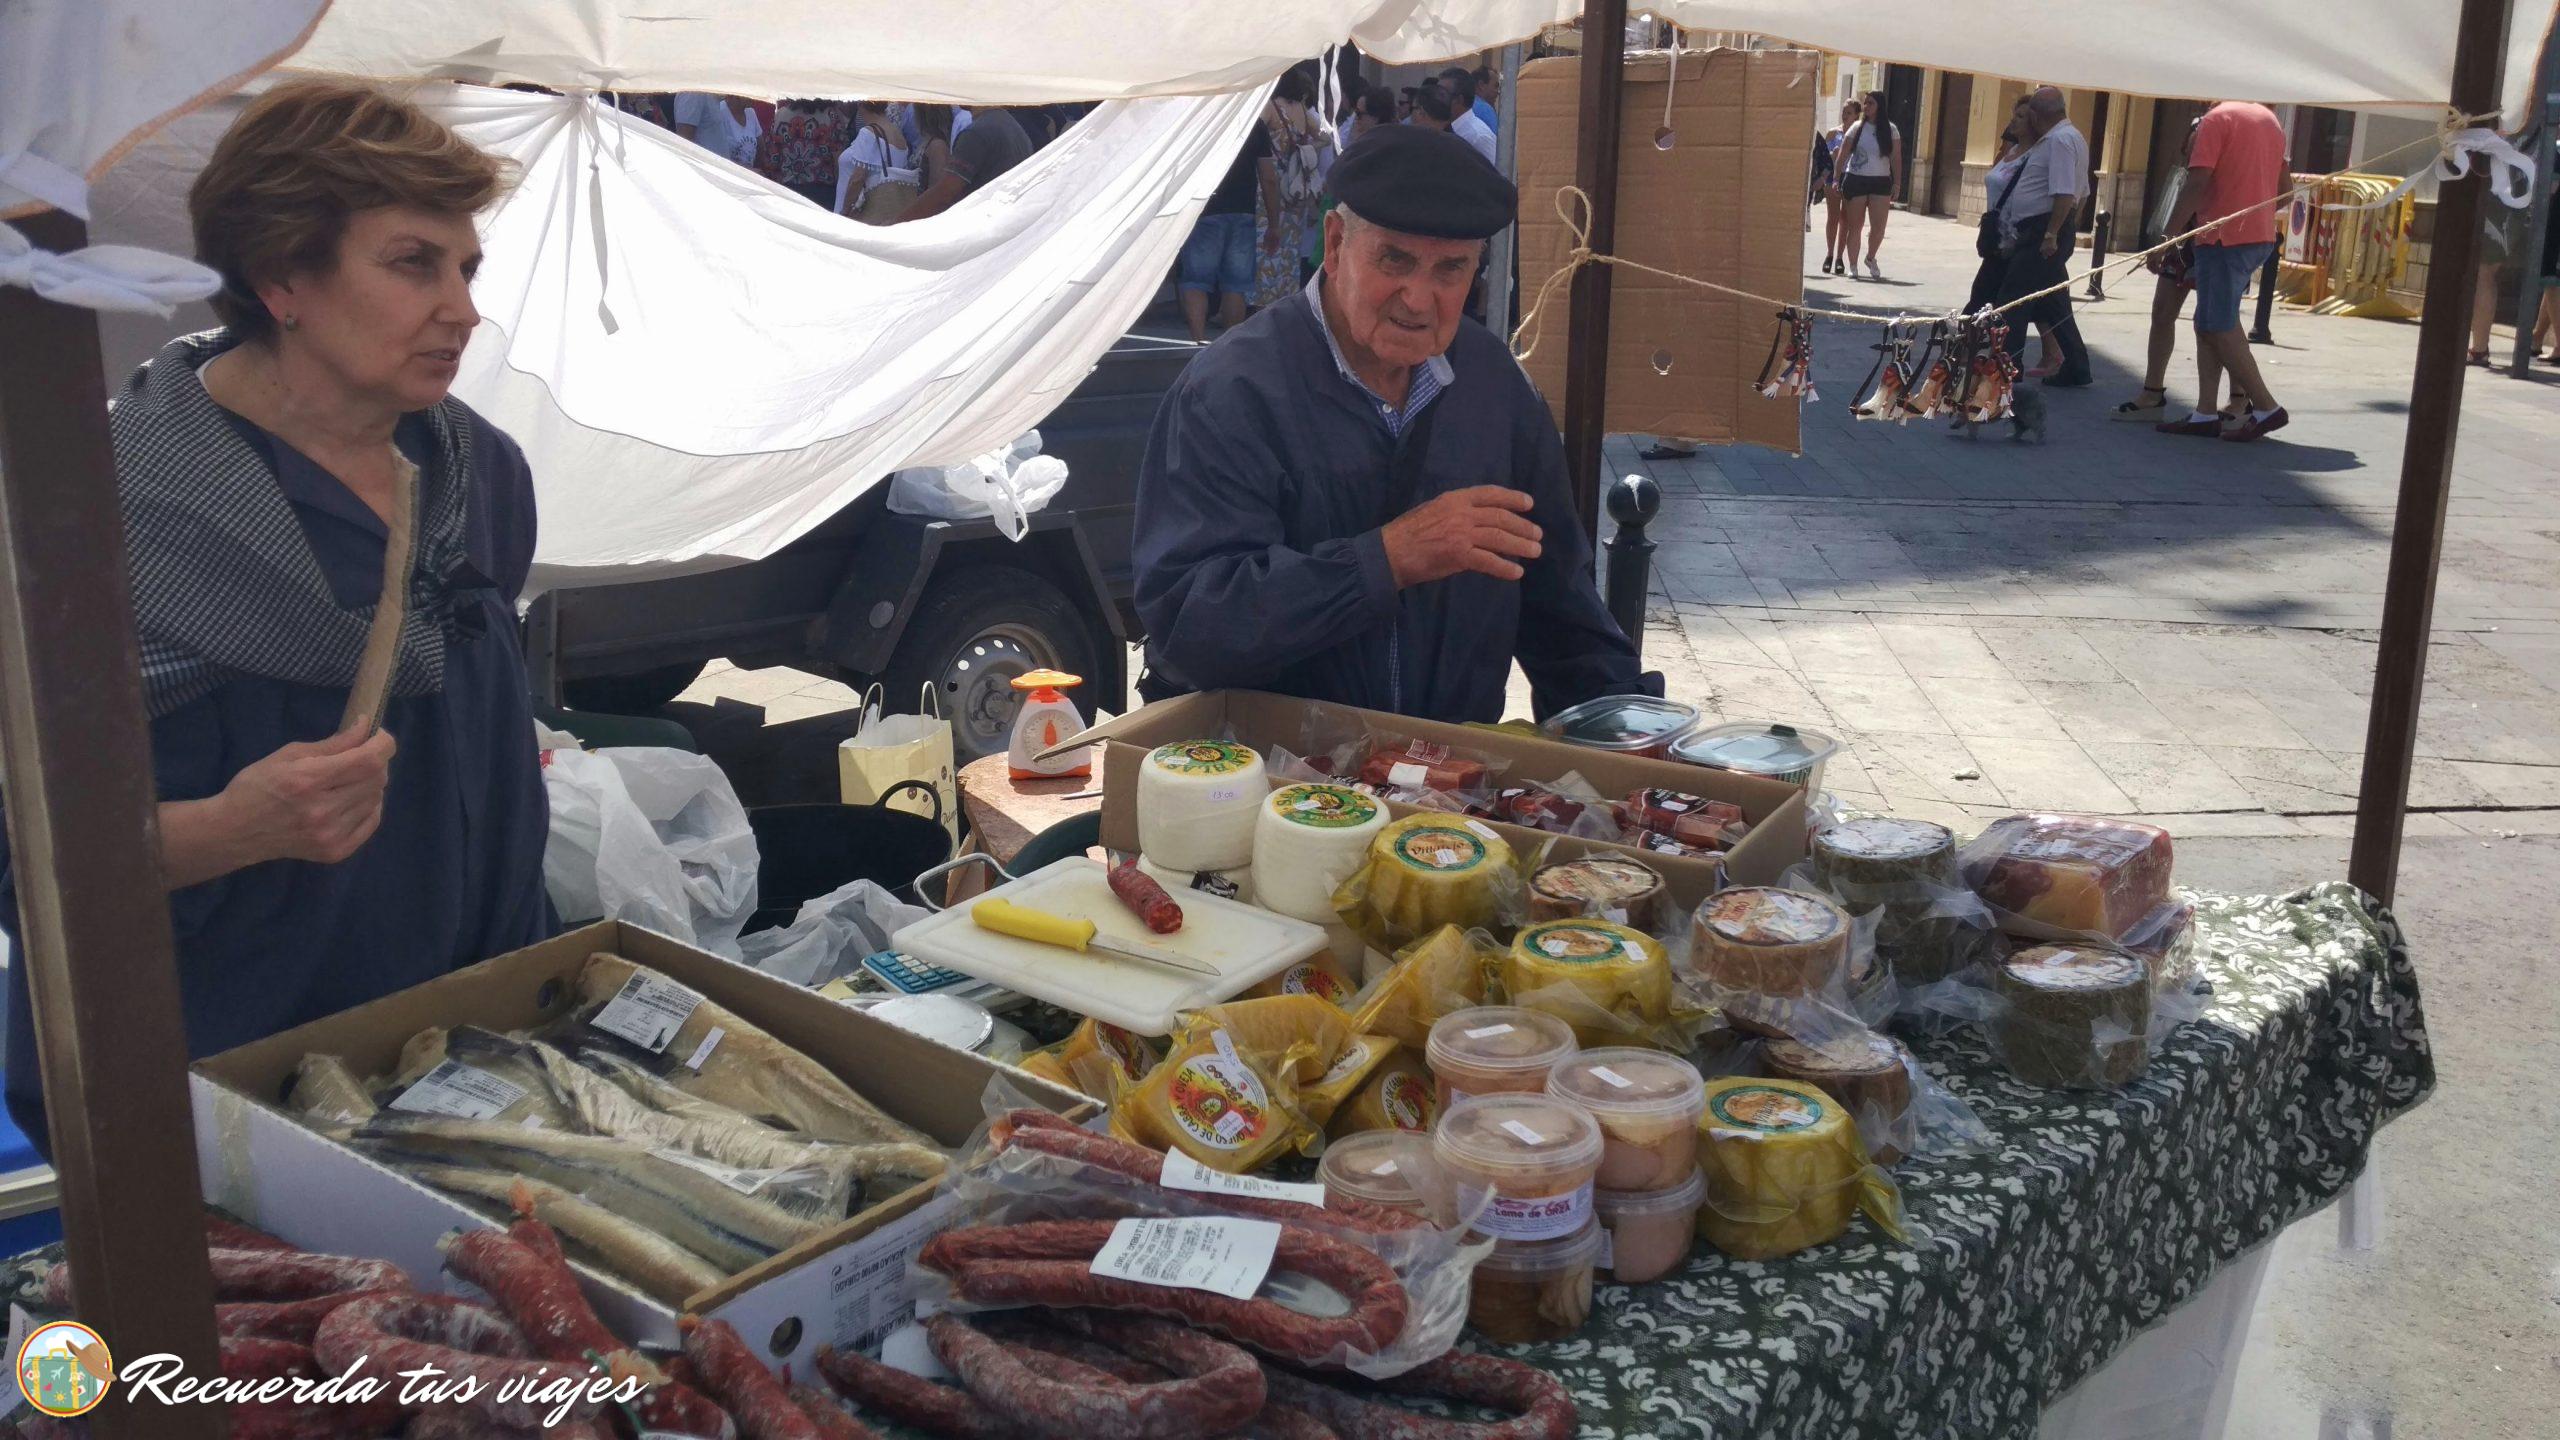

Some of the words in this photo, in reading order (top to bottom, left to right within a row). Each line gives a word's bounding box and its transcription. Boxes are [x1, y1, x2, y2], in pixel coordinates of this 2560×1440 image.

[1174, 1066, 1196, 1095] OVEJA
[1199, 1128, 1213, 1143] DE
[1495, 1207, 1524, 1219] Lomo
[1527, 1210, 1541, 1218] de
